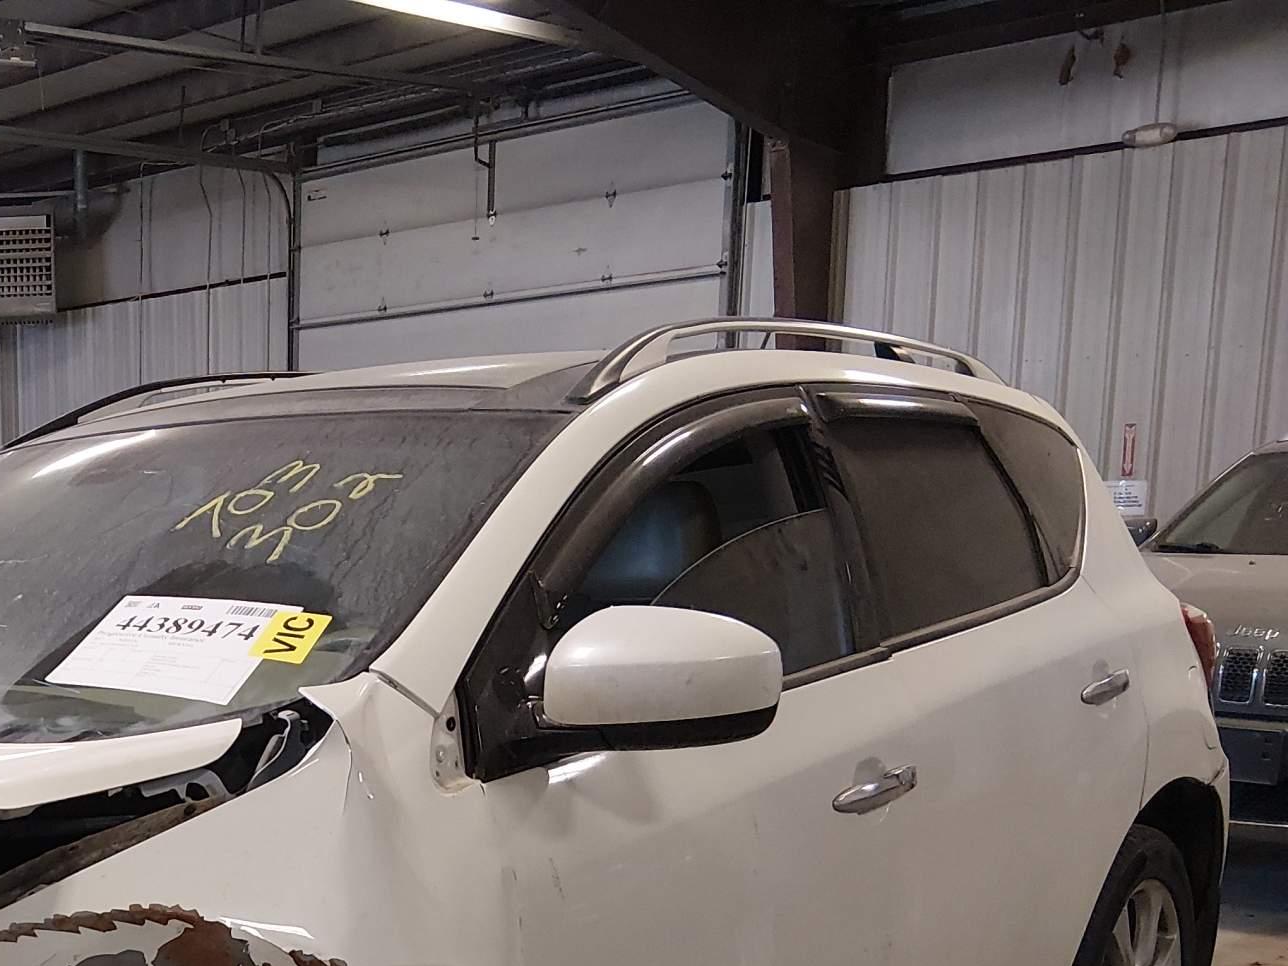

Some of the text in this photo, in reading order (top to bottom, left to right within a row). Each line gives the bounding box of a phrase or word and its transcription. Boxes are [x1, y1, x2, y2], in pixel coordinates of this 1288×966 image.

[116, 615, 260, 641] 44389474
[263, 615, 316, 655] VIC
[1225, 624, 1280, 641] Jeep
